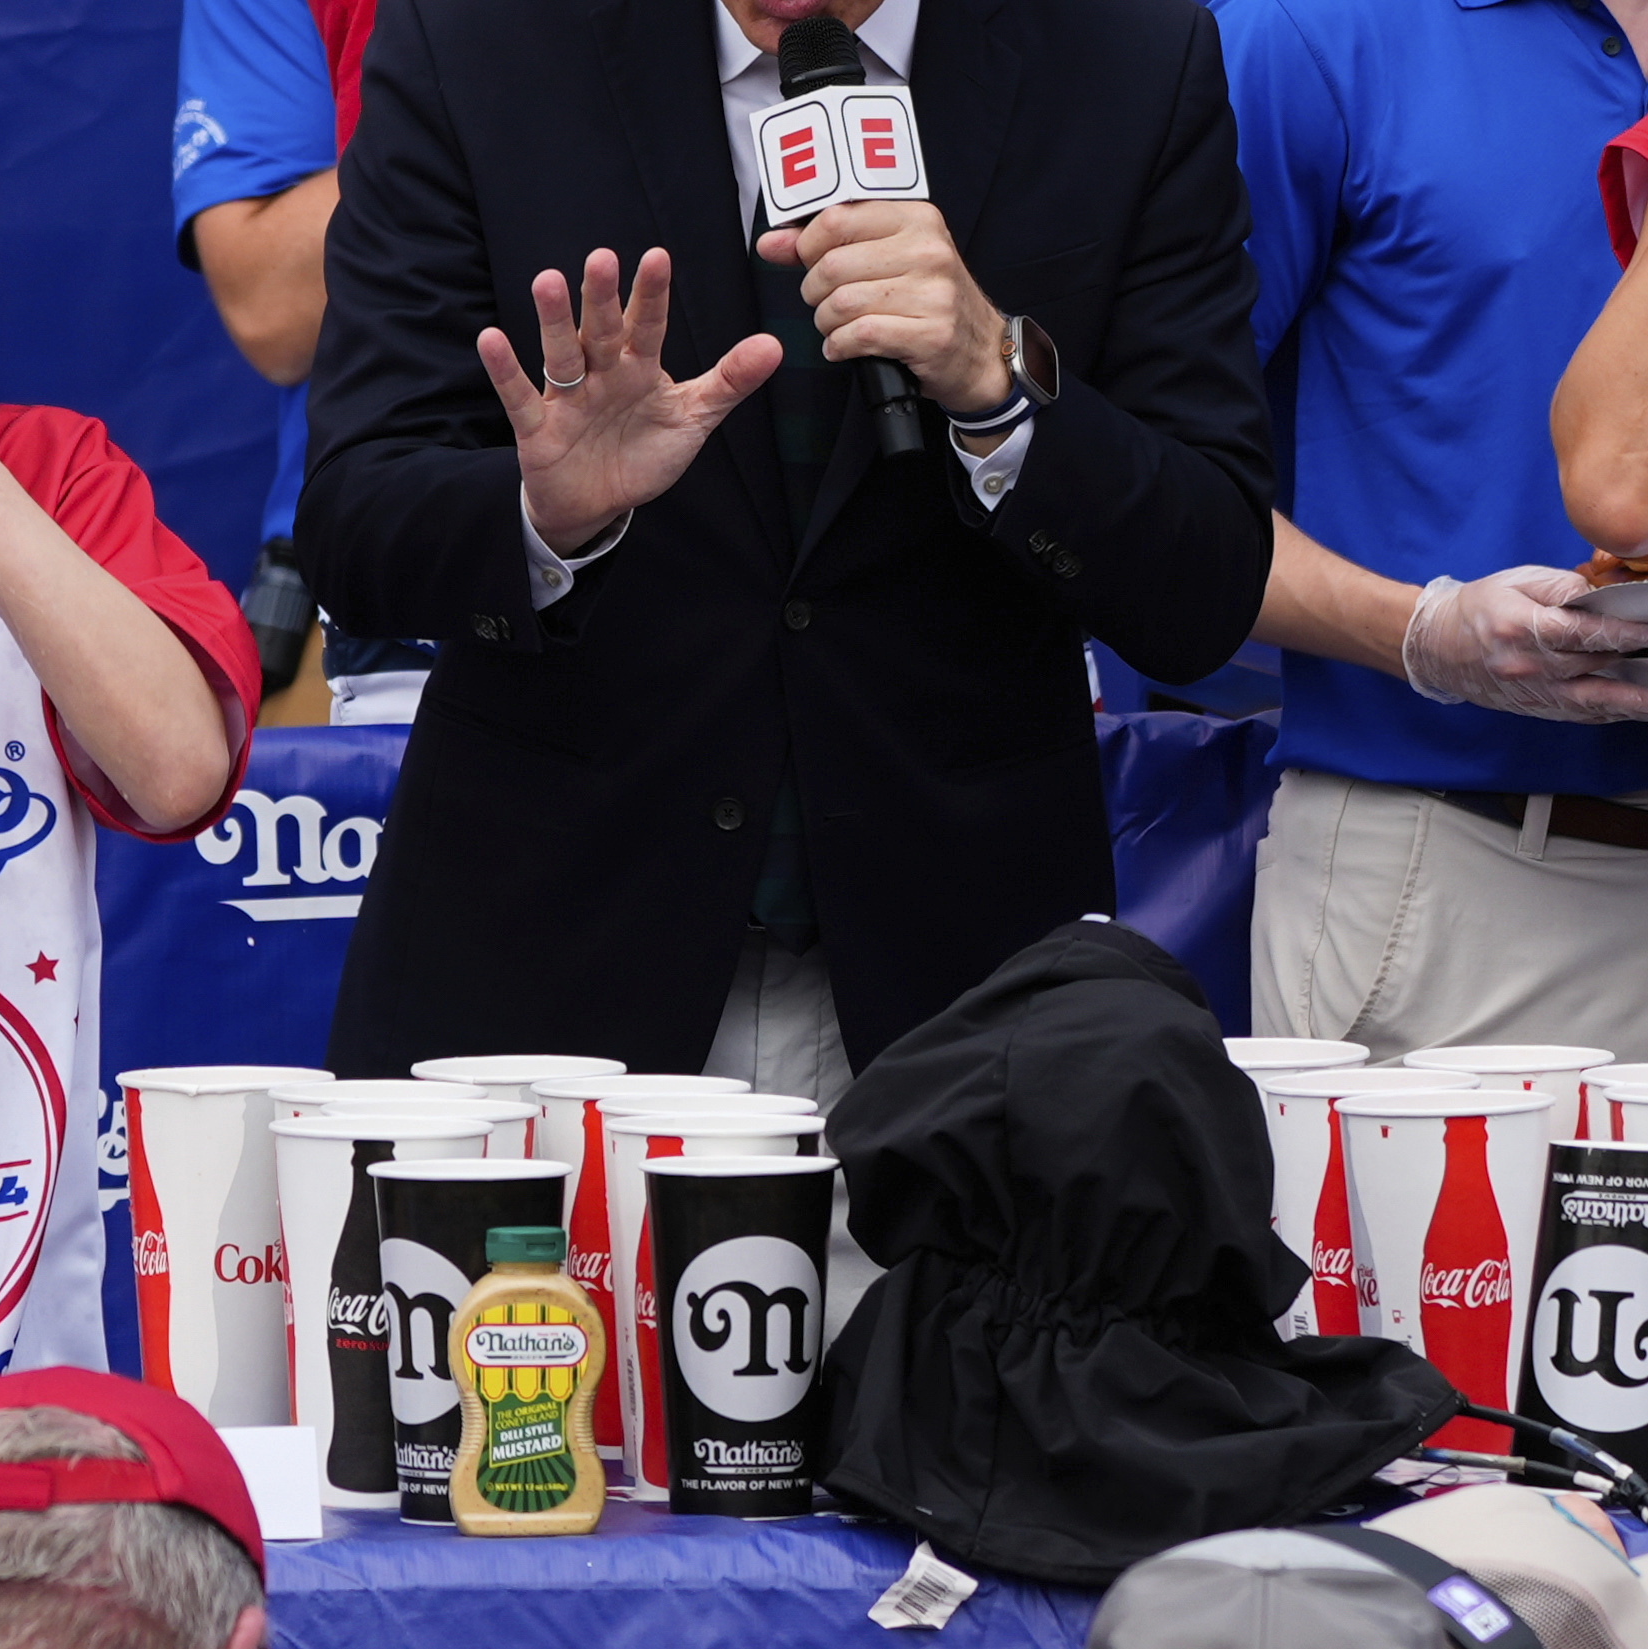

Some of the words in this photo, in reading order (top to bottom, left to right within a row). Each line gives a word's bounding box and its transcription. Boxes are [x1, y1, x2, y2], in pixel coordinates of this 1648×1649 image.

[1575, 1173, 1604, 1186] NEW
[1606, 1175, 1623, 1188] OF
[214, 1242, 284, 1286] Cok
[1420, 1258, 1513, 1310] Coca-Cola
[475, 1330, 579, 1353] Nathan's
[499, 1427, 523, 1443] DELI
[524, 1421, 554, 1437] STYLE
[492, 1434, 563, 1462] MUSTARD
[693, 1437, 805, 1467] Nathan's
[681, 1478, 700, 1489] THE
[701, 1479, 747, 1491] FLAVOR
[749, 1479, 766, 1490] OF
[768, 1479, 792, 1490] NEW
